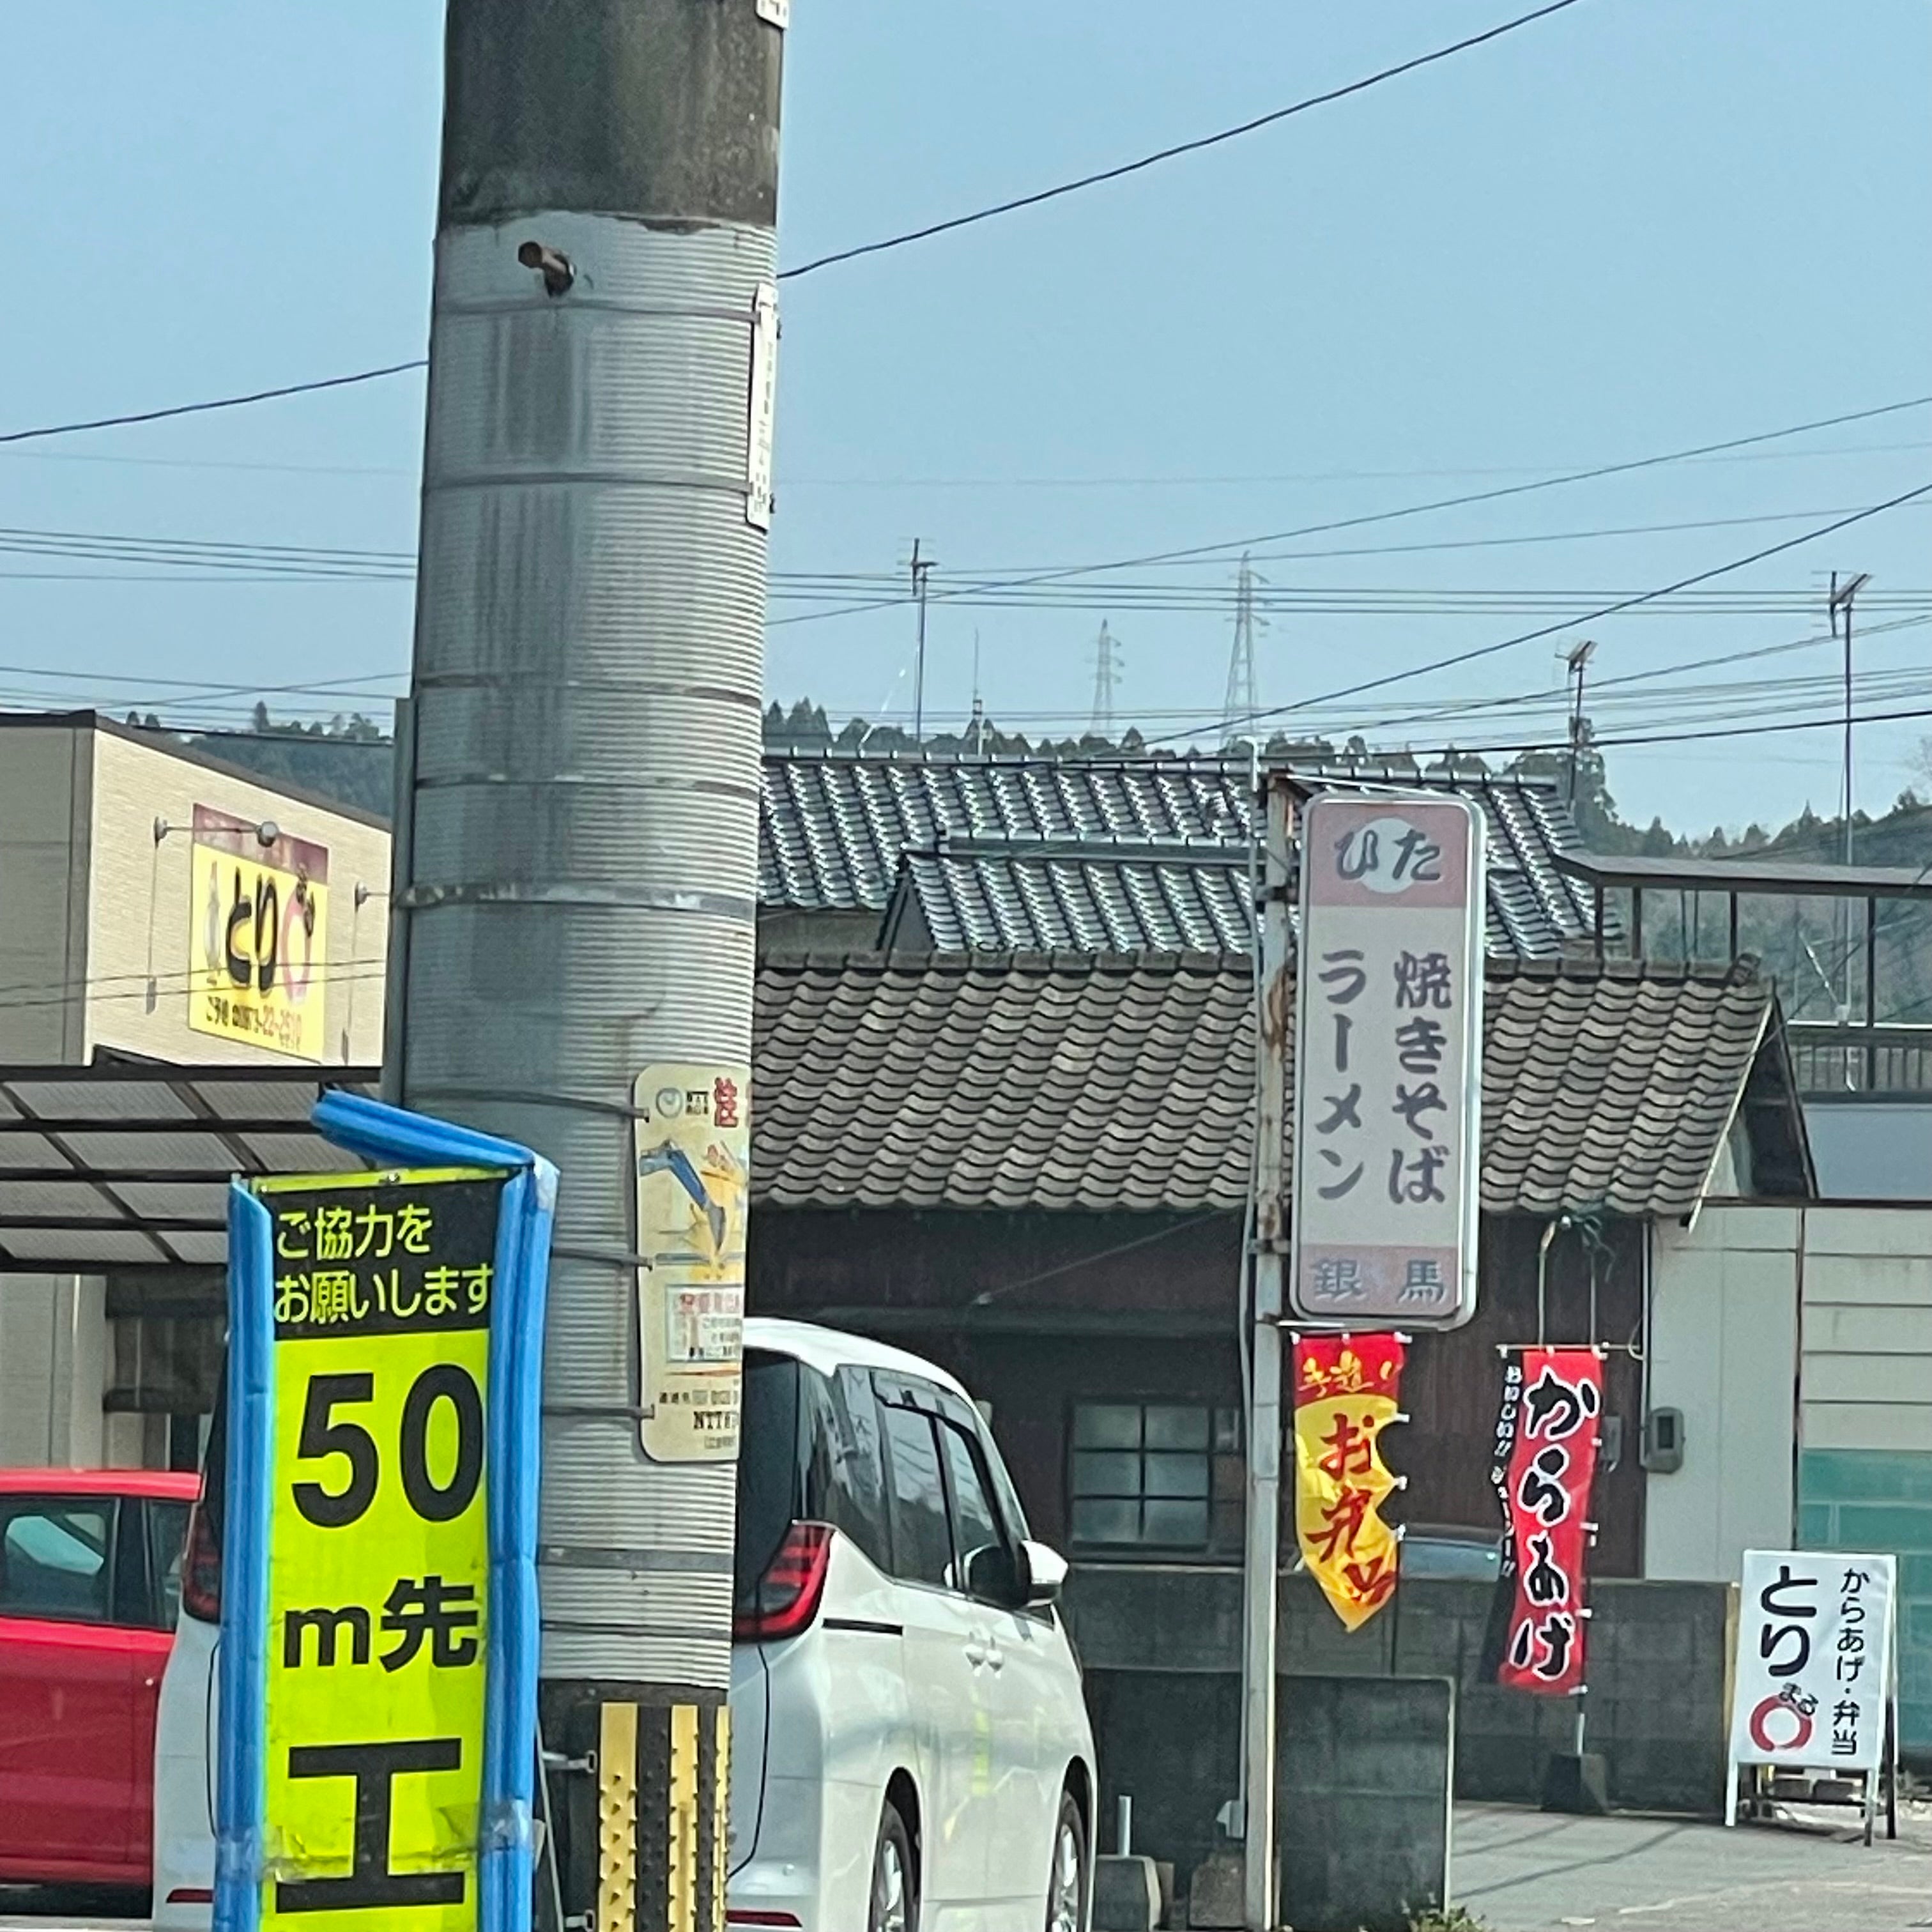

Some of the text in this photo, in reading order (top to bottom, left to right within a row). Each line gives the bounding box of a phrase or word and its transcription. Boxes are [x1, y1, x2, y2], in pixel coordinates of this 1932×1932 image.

[1314, 949, 1367, 1201] ラーメン
[1389, 950, 1452, 1205] 焼きそば
[273, 1263, 493, 1324] お願いします
[277, 1203, 433, 1261] ご協力を
[291, 1362, 484, 1529] 50
[1508, 1365, 1599, 1680] からあげ
[284, 1575, 479, 1673] m先
[1760, 1565, 1818, 1677] とり
[1832, 1568, 1871, 1756] からあげ・弁当
[276, 1736, 465, 1914] 工
